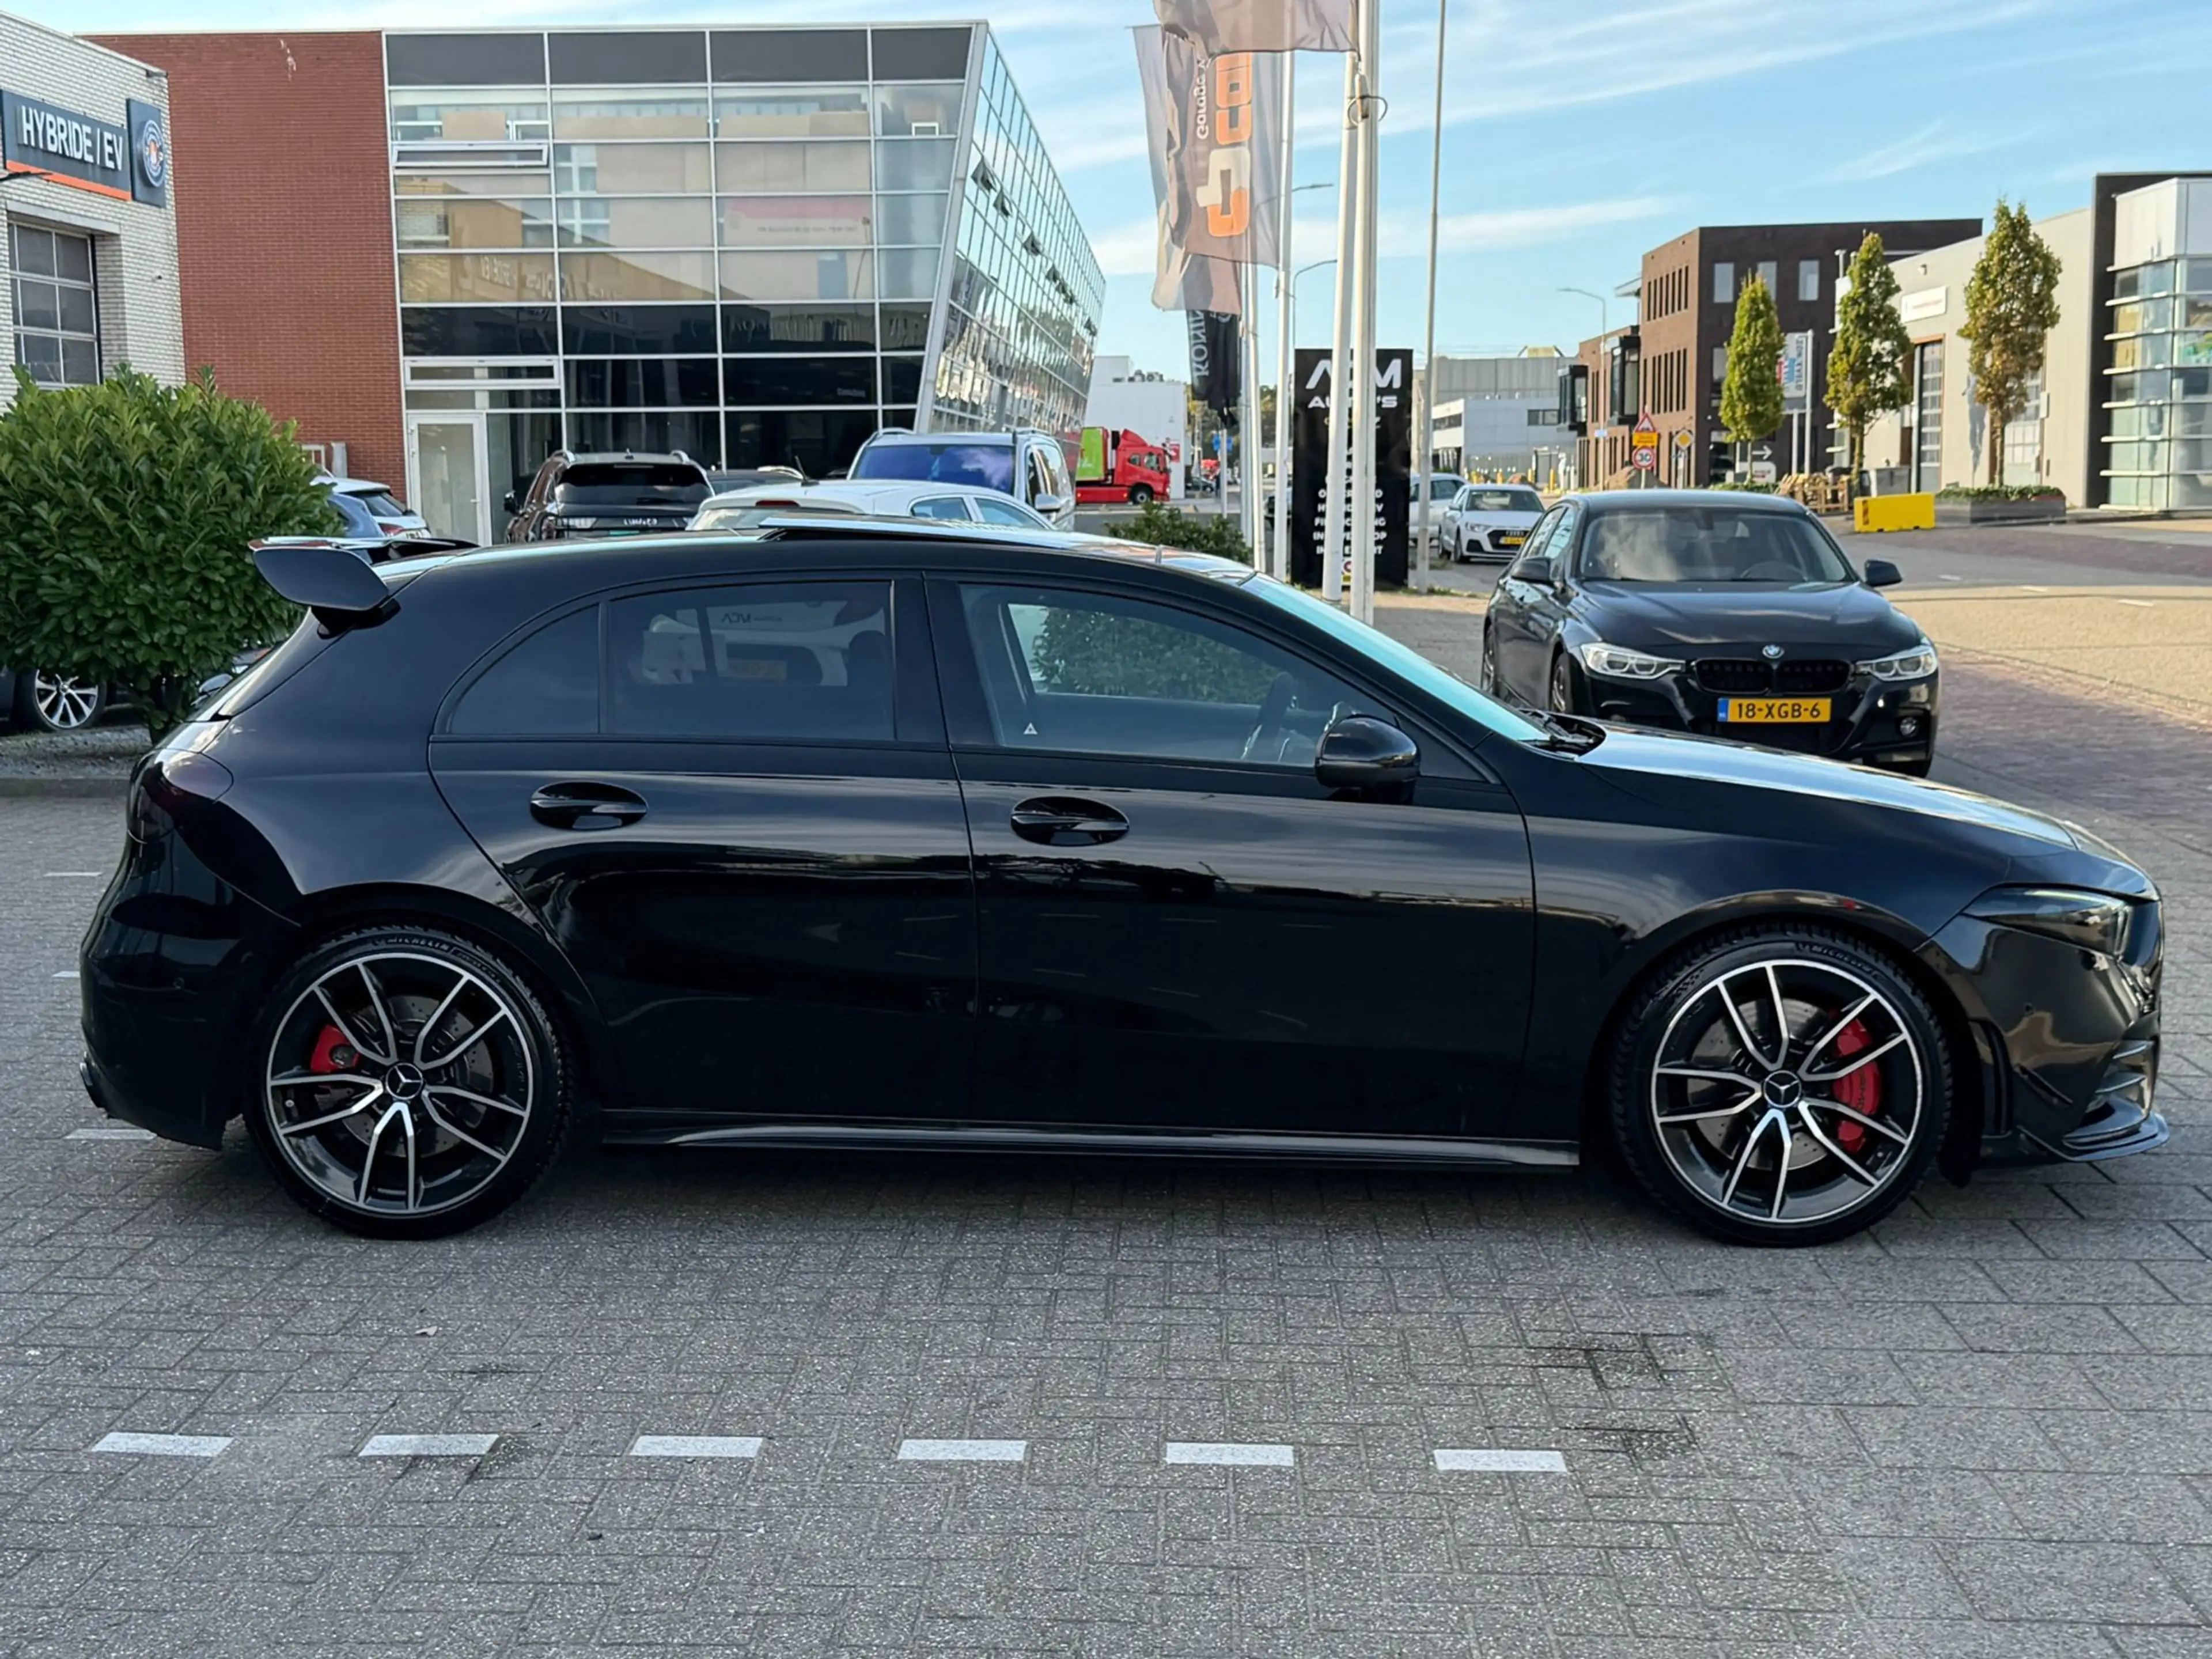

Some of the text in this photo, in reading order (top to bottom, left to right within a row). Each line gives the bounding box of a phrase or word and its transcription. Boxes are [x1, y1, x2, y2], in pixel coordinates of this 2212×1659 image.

[22, 105, 94, 163] HYBRIDE
[104, 131, 123, 171] EV
[1305, 358, 1402, 389] AM
[1308, 395, 1397, 408] A'S
[1638, 452, 1652, 463] 30
[1737, 702, 1821, 719] 18-XGB-6
